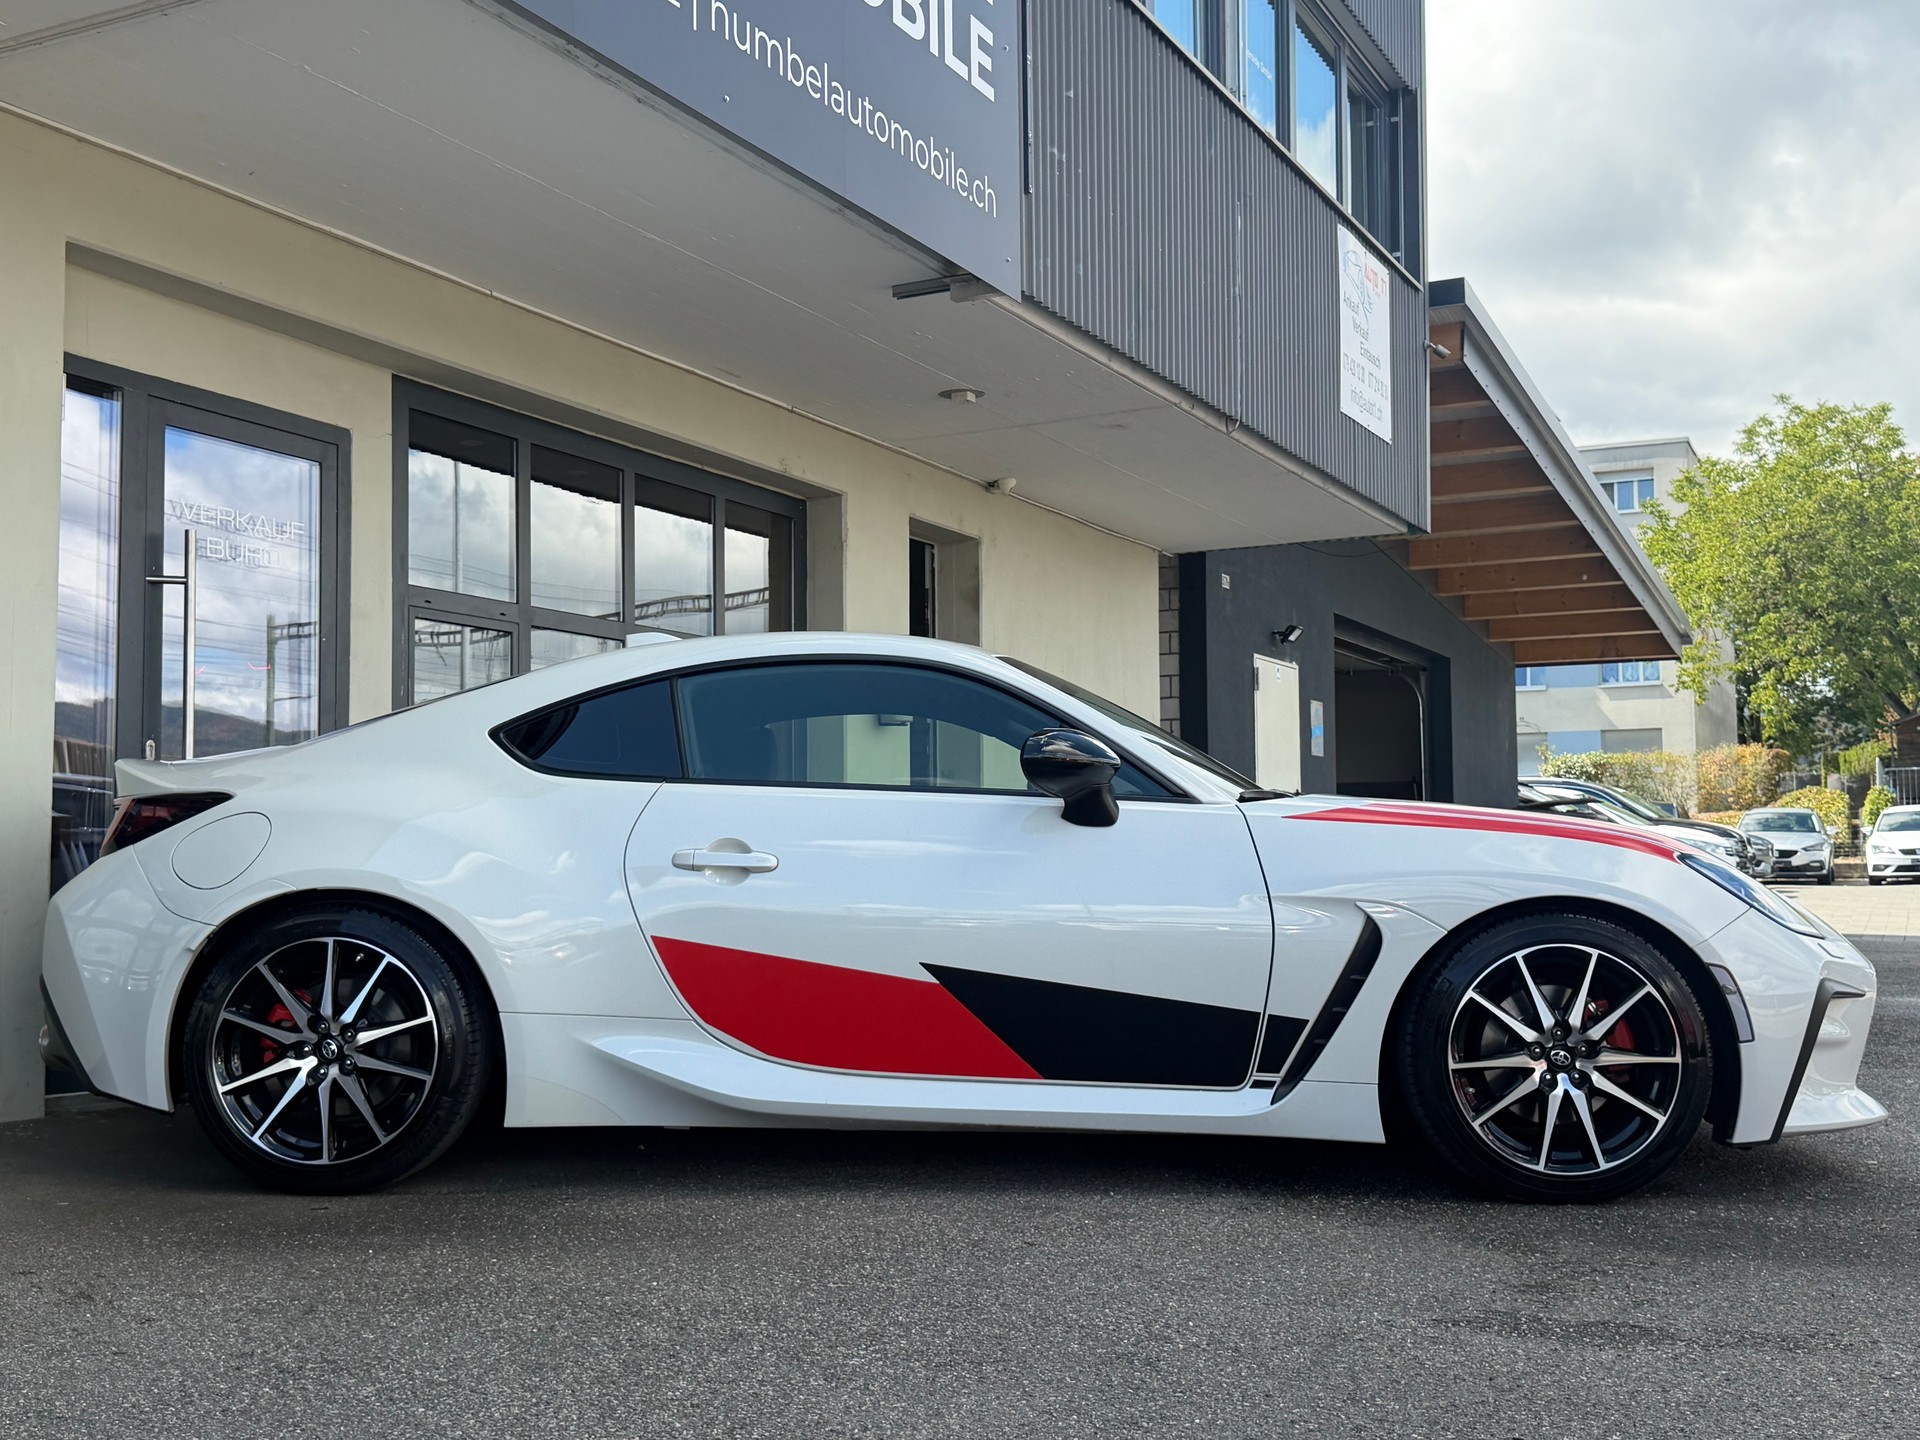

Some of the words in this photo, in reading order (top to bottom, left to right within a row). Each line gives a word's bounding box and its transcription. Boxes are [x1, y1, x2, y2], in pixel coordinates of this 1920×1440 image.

[711, 0, 997, 218] humbelautomobile.ch
[1352, 315, 1369, 342] Verkauf
[1360, 340, 1381, 370] Eintausch
[180, 498, 305, 540] VERKAUF
[206, 535, 281, 568] BÜRO
